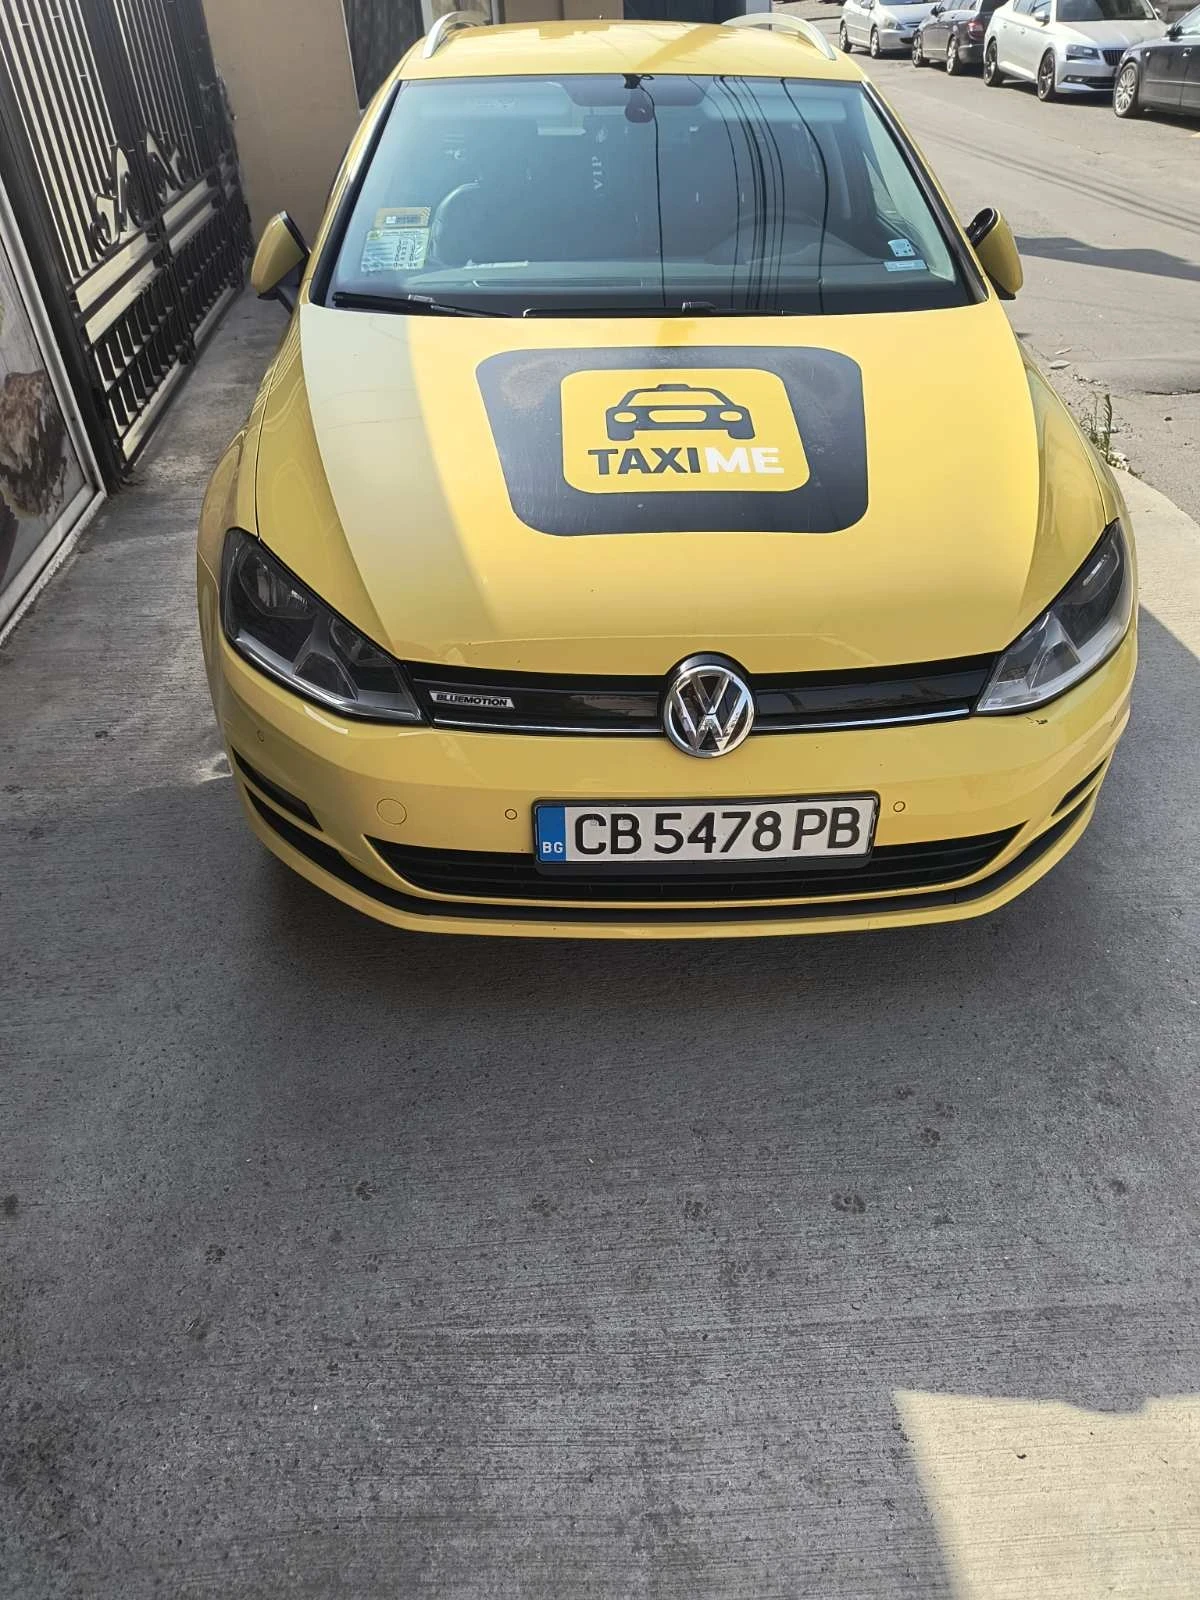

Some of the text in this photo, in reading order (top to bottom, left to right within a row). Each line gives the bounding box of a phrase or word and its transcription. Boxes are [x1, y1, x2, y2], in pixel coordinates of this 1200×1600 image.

[435, 692, 510, 708] BLUEMOTION
[667, 669, 753, 756] VW
[574, 805, 862, 856] CB 5478 PB
[541, 840, 565, 855] BG
